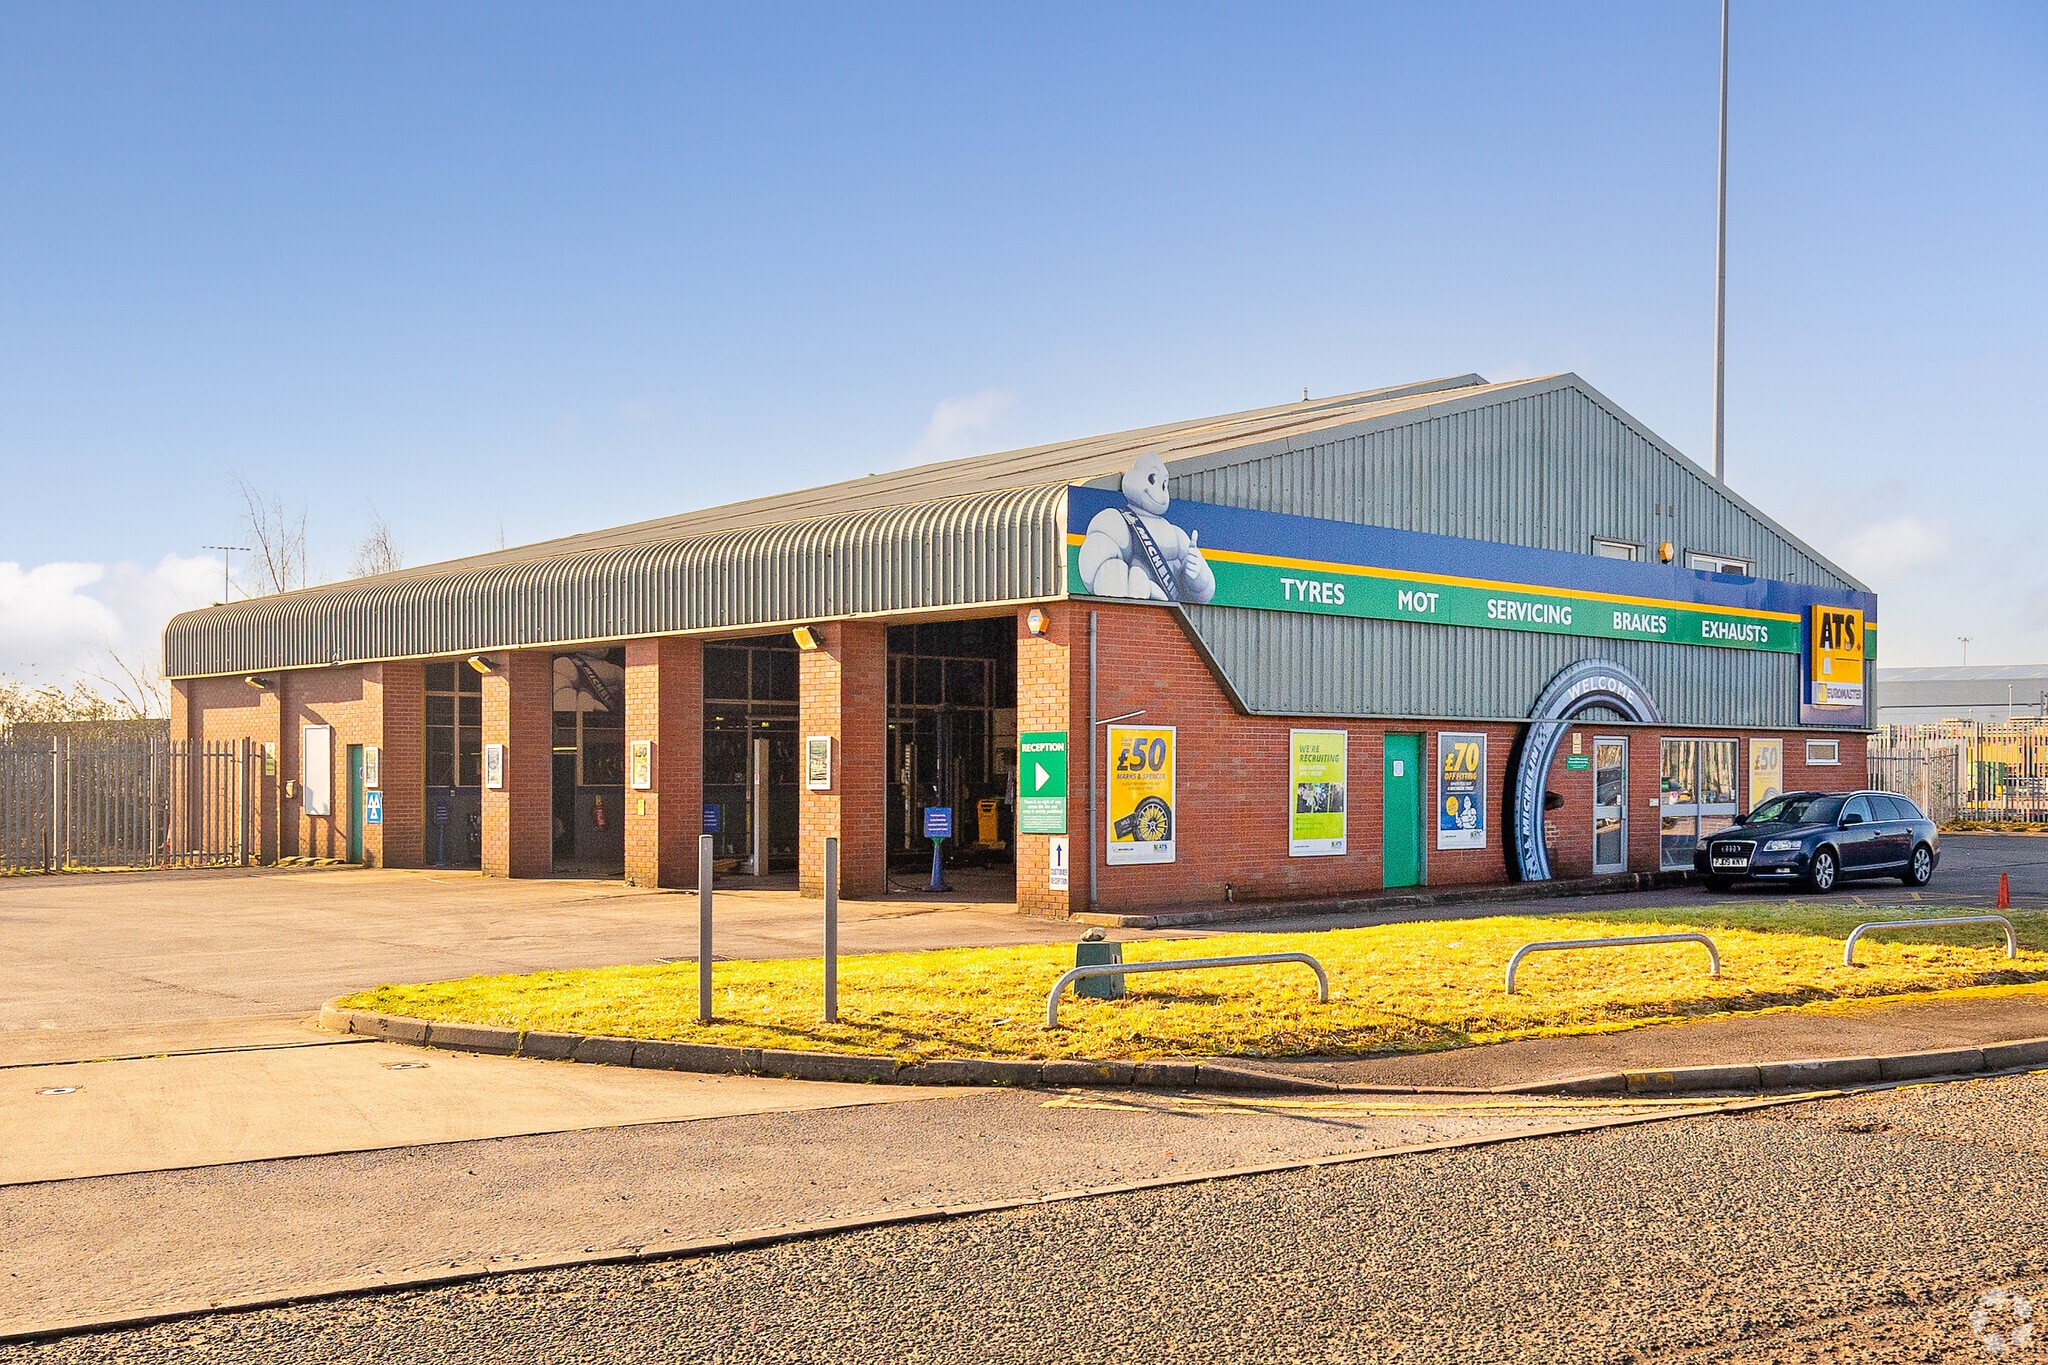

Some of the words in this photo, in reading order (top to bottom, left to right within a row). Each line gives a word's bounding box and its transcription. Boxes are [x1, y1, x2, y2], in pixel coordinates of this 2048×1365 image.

[1136, 526, 1179, 600] MICHELIN
[1280, 577, 1345, 606] TYRES
[1397, 589, 1440, 614] MOT
[1486, 598, 1573, 626] SERVICING
[1612, 610, 1668, 635] BRAKES
[1701, 619, 1769, 643] EXHAUSTS
[1819, 612, 1855, 652] ATS
[1567, 675, 1635, 704] WELCOME
[1827, 687, 1863, 700] EUROMASTER
[1021, 742, 1065, 753] RECEPTION
[1116, 737, 1167, 772] £50
[1298, 744, 1320, 754] WE'RE
[1298, 754, 1340, 763] RECRUITING
[1444, 742, 1480, 772] £70
[1754, 746, 1778, 770] £50
[1521, 745, 1540, 838] MICHELIN
